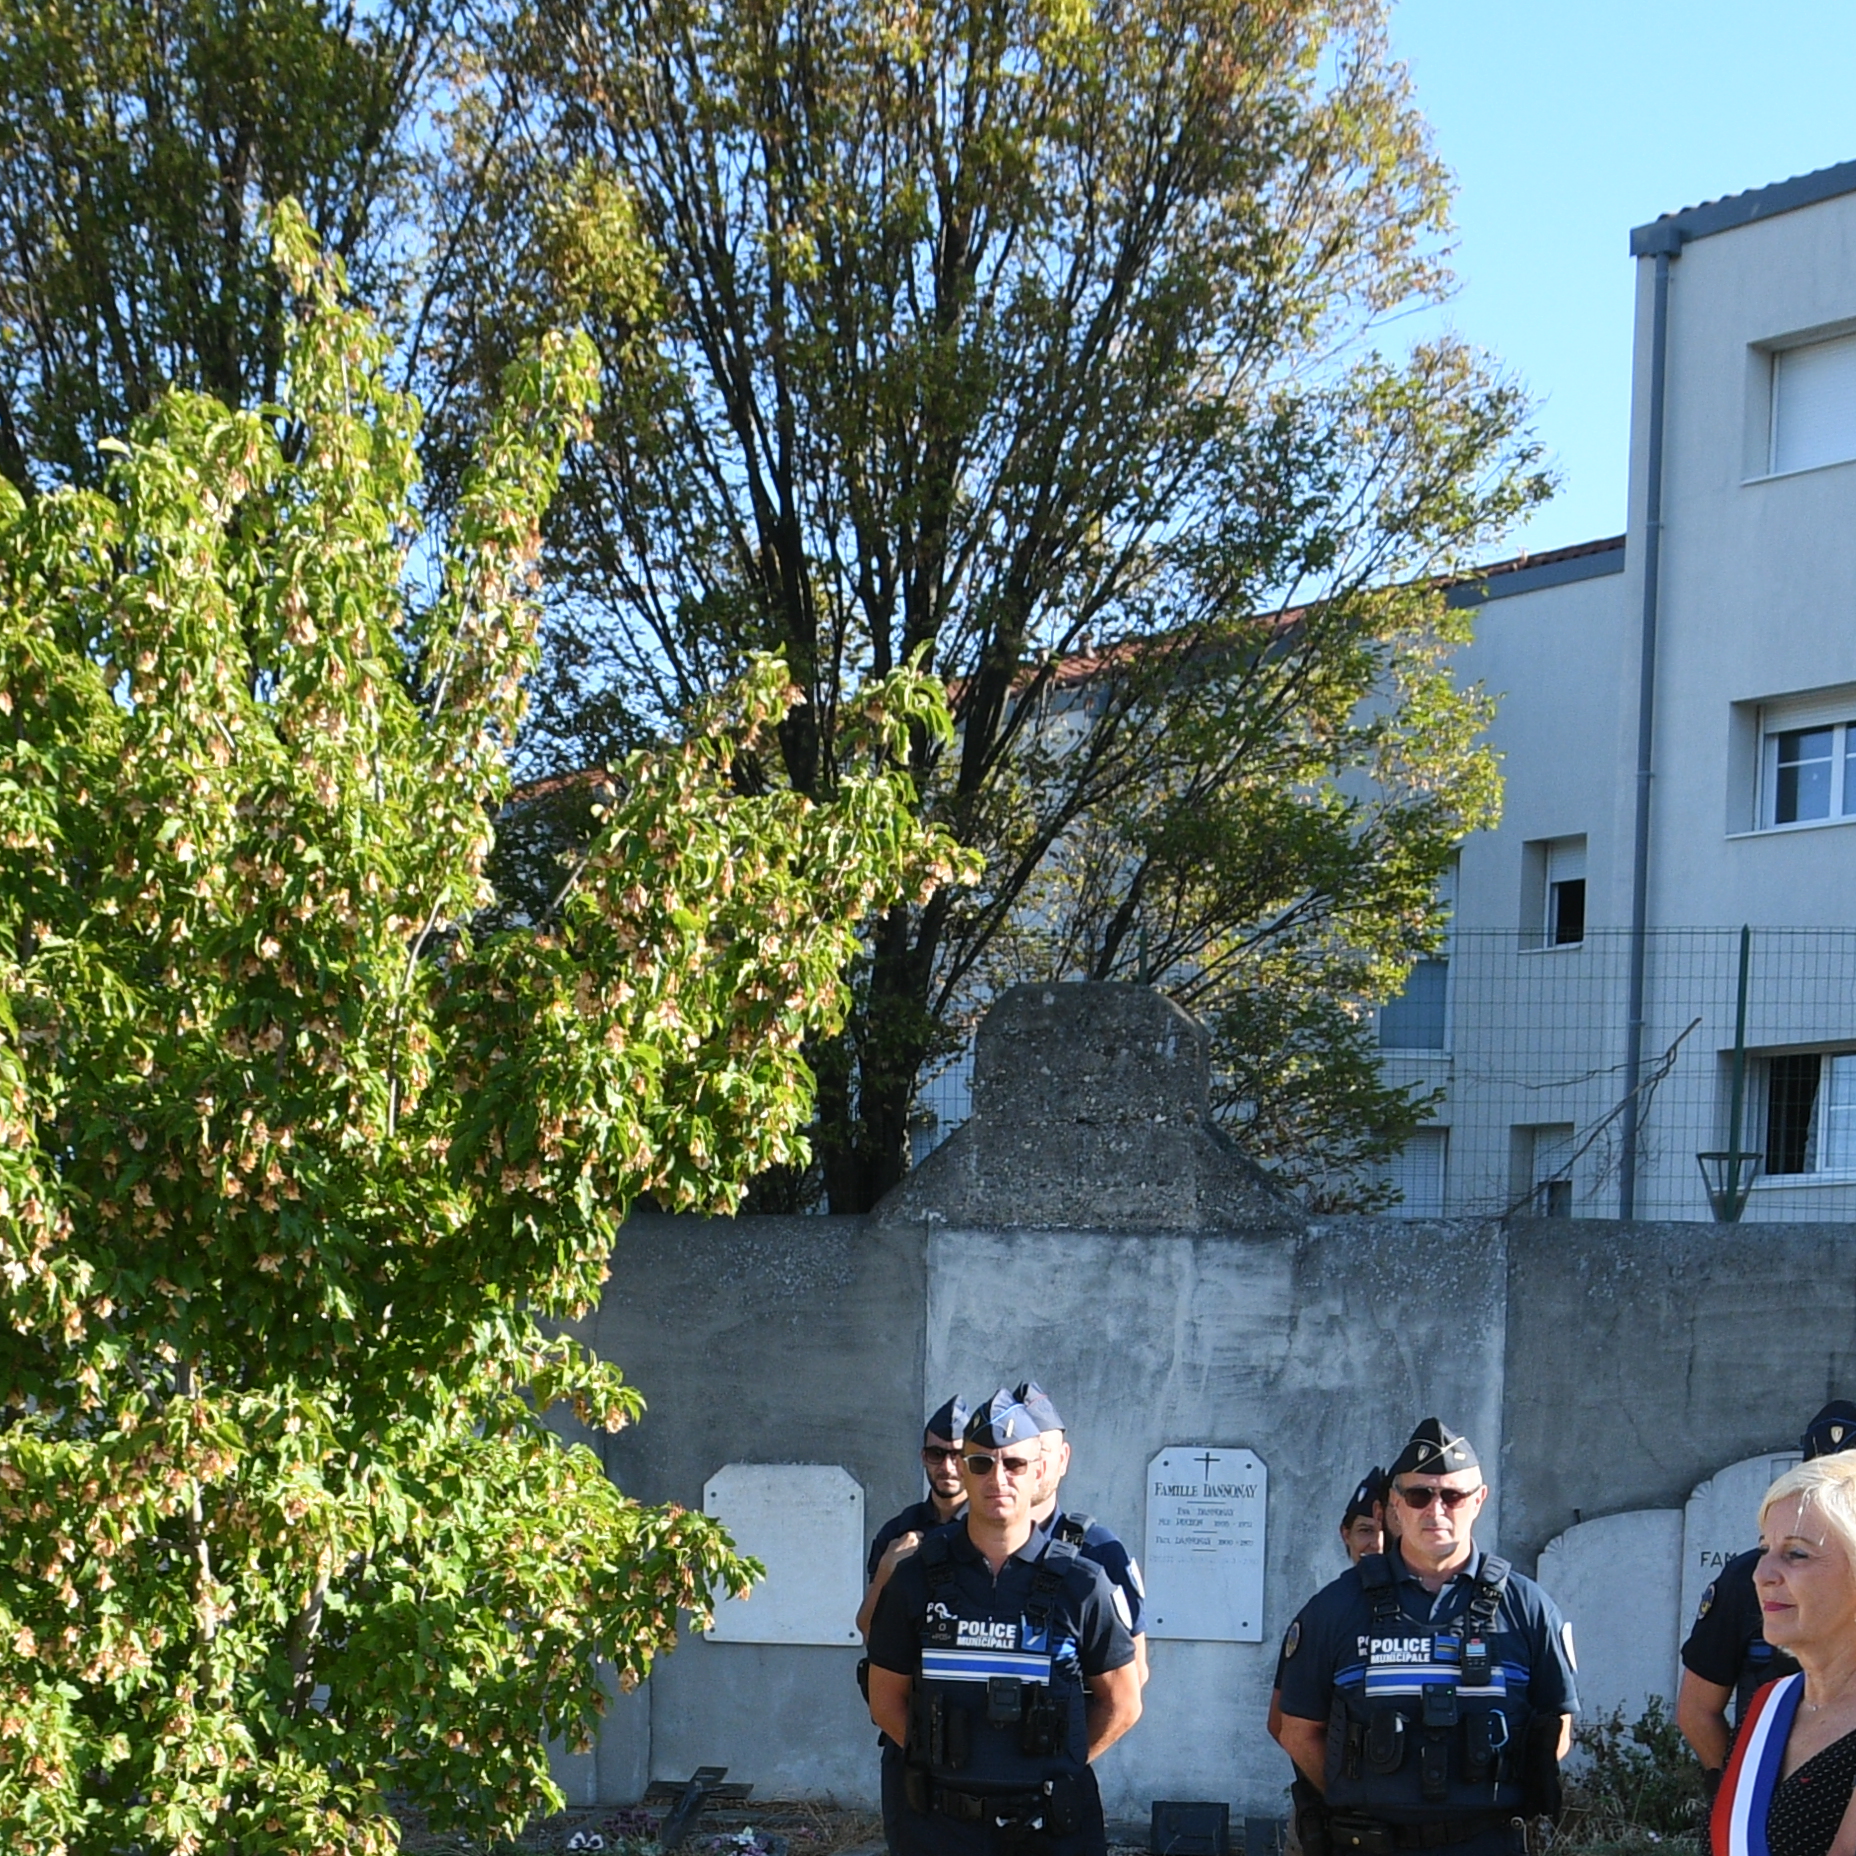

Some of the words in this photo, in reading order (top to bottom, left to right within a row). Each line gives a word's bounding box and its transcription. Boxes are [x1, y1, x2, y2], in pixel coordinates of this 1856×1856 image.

[1154, 1482, 1198, 1498] FAMILLE
[958, 1621, 1017, 1639] POLICE
[956, 1636, 1015, 1649] MUNICIPALE
[1370, 1638, 1431, 1653] POLICE
[1370, 1653, 1430, 1664] MUNICIPALE
